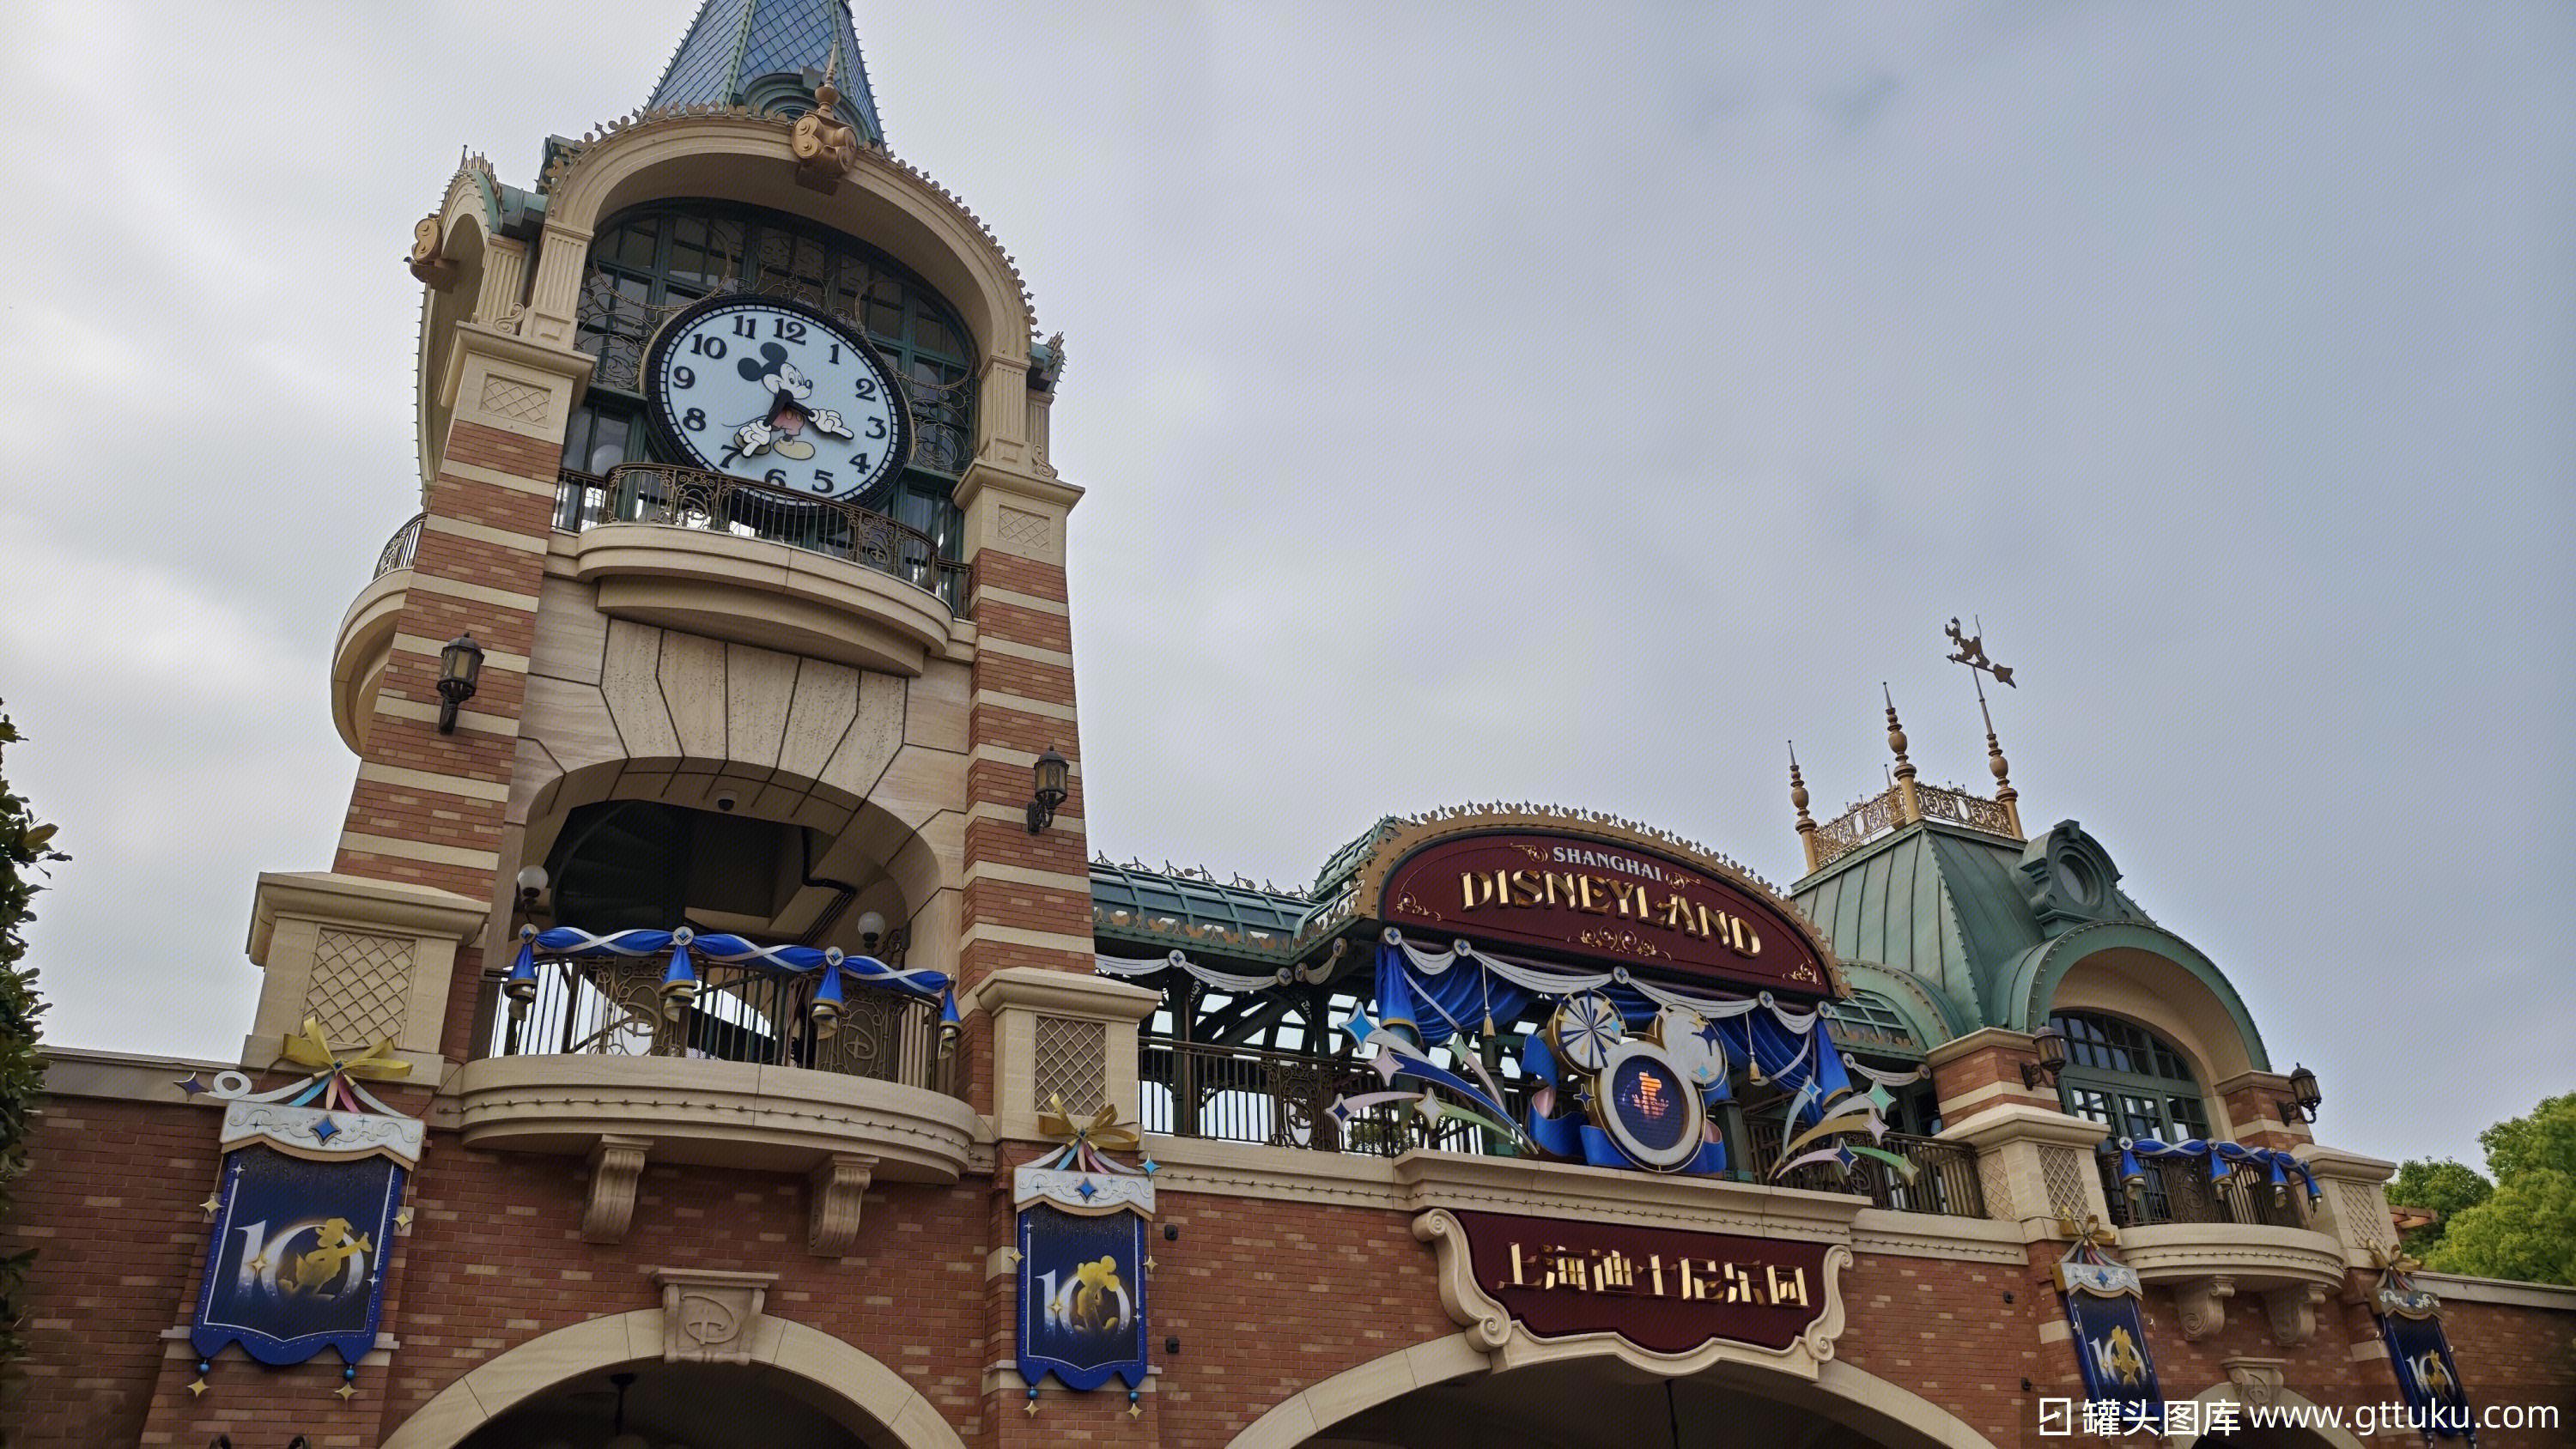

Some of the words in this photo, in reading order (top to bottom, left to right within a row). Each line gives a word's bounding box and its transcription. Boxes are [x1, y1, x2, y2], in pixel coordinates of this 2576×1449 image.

[732, 315, 756, 339] 11
[774, 318, 806, 345] 12
[690, 334, 727, 360] 10
[829, 343, 840, 365] 1
[672, 366, 696, 389] 9
[855, 378, 877, 402] 2
[683, 408, 706, 431] 8
[865, 415, 887, 440] 3
[720, 444, 743, 469] 7
[849, 452, 871, 475] 4
[764, 469, 787, 488] 6
[811, 469, 834, 494] 5
[1552, 846, 1662, 882] SHANGHAI
[1460, 869, 1763, 959] DISNEYLAND
[234, 1219, 365, 1301] 10
[1498, 1241, 1810, 1308] 上海迪士尼乐园
[1034, 1268, 1131, 1337] 10
[2088, 1337, 2147, 1385] 10
[2405, 1354, 2456, 1397] 10
